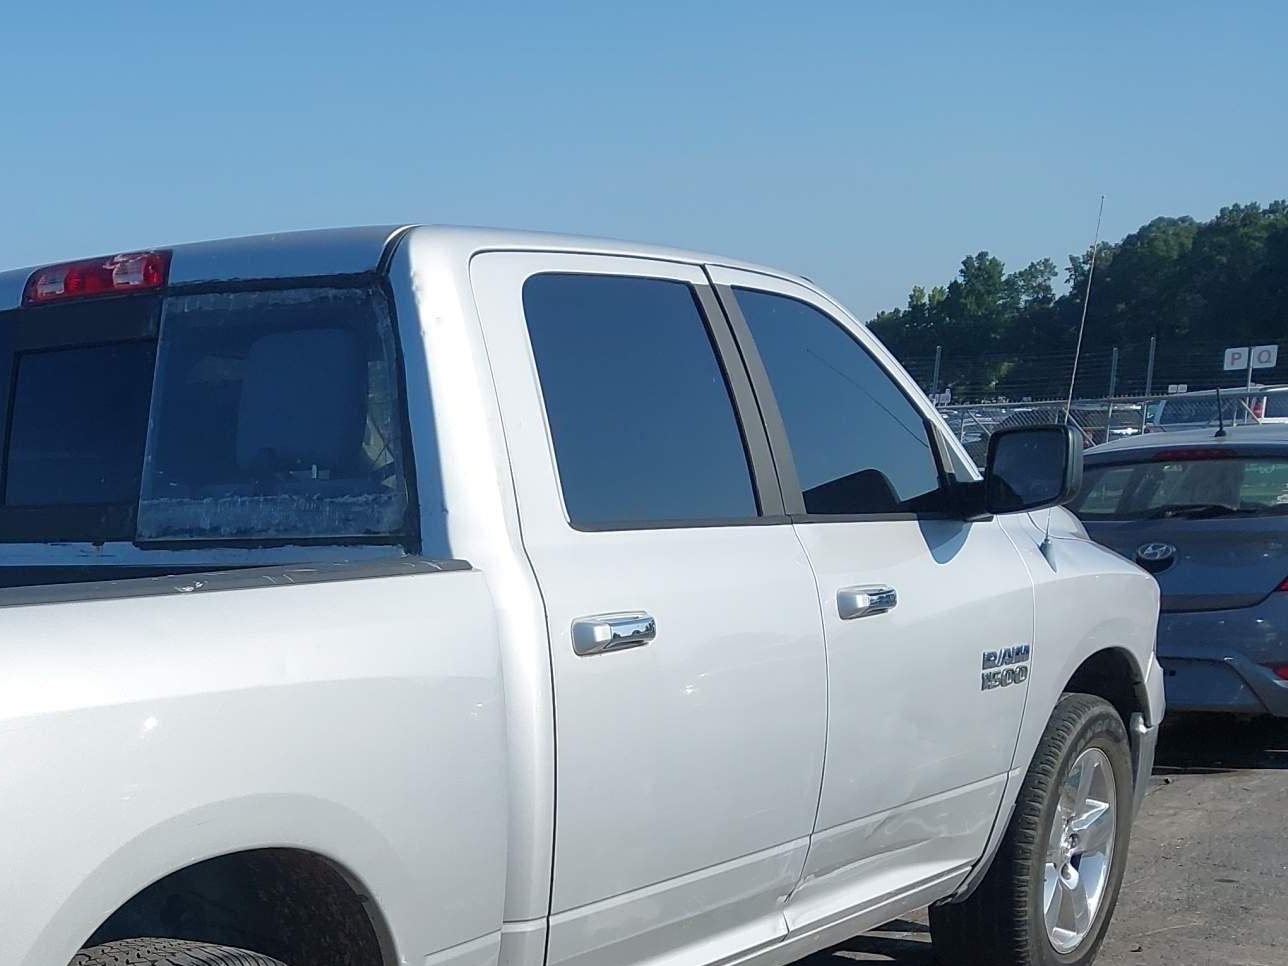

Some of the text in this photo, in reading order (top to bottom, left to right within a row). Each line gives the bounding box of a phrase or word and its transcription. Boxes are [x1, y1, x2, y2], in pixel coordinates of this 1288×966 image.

[1230, 352, 1242, 366] P
[1257, 350, 1273, 364] Q
[981, 645, 1030, 670] RAM
[981, 665, 1028, 691] 1500
